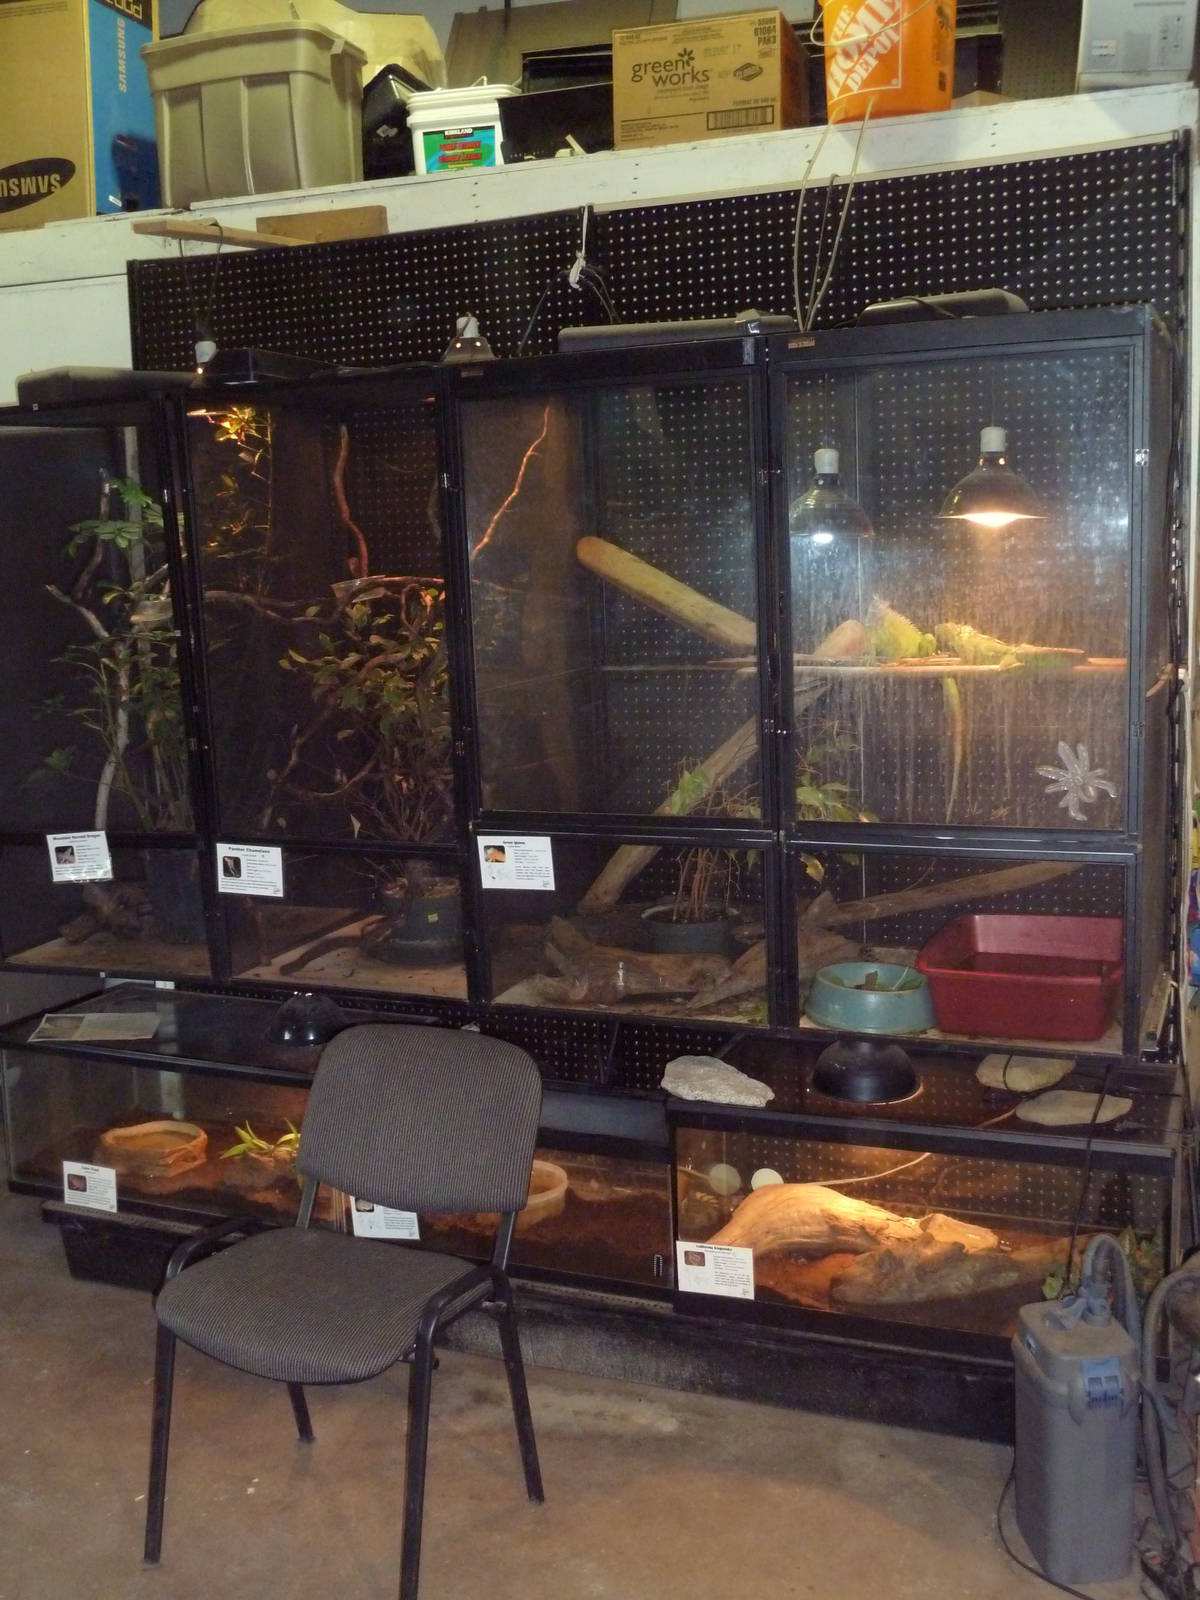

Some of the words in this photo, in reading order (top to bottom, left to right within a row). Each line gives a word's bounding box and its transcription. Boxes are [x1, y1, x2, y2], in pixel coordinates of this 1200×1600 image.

[117, 18, 127, 93] SAMSUNG
[631, 58, 686, 83] green
[652, 66, 710, 88] works
[846, 29, 901, 92] DEPOT
